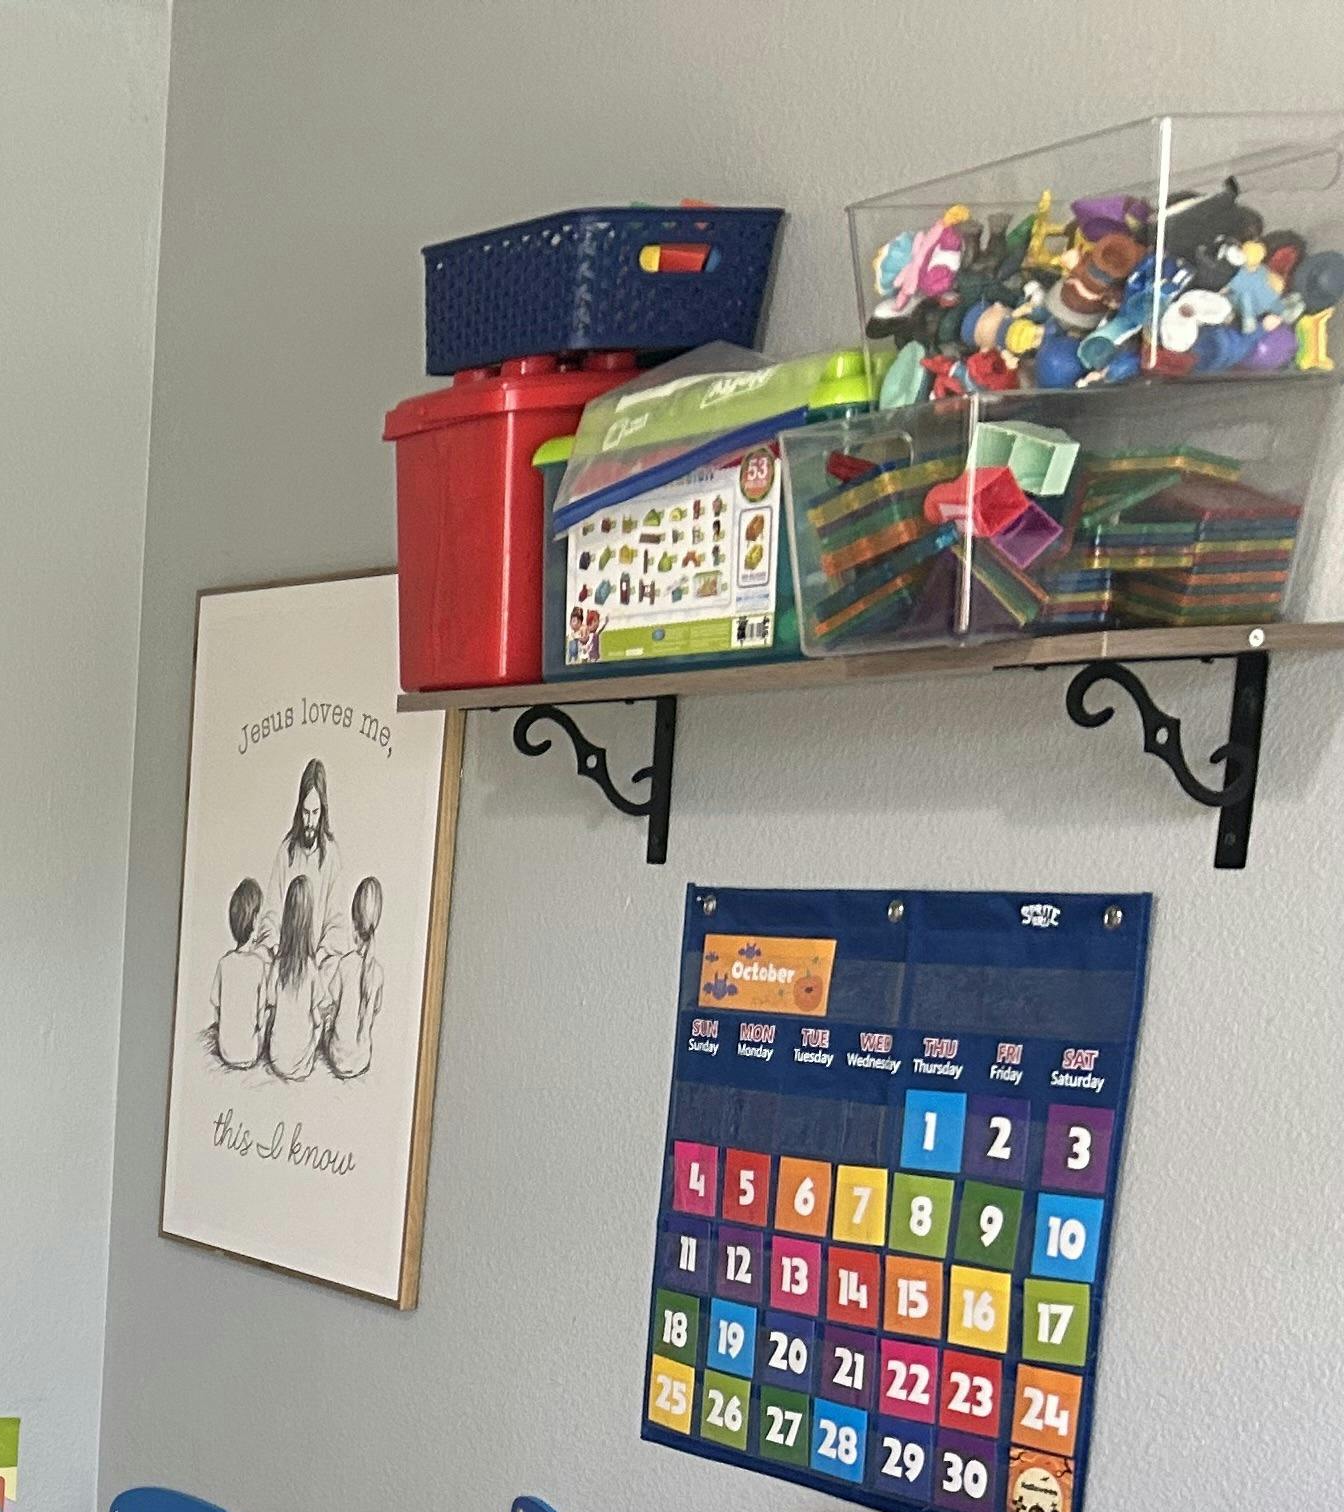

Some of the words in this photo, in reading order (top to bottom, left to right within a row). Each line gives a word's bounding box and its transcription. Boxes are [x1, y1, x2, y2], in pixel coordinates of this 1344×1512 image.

[746, 457, 768, 481] 53
[238, 707, 294, 755] Jesus
[302, 698, 353, 728] loves
[360, 713, 392, 758] me,
[731, 961, 795, 984] October
[688, 1038, 719, 1055] Sunday
[737, 1043, 773, 1060] Monday
[793, 1048, 834, 1068] Tuesday
[847, 1053, 901, 1074] Wednesday
[913, 1060, 962, 1079] Thursday
[990, 1065, 1022, 1085] Friday
[1051, 1071, 1104, 1092] Saturday
[692, 1019, 719, 1038] SUN
[740, 1022, 775, 1042] MON
[801, 1028, 829, 1047] TUE
[860, 1033, 892, 1052] WED
[923, 1037, 957, 1058] THU
[996, 1042, 1022, 1063] FRI
[1062, 1049, 1099, 1071] SAT
[213, 1109, 253, 1156] this
[256, 1122, 284, 1159] I
[288, 1122, 355, 1175] know
[923, 1113, 935, 1149] 1
[987, 1117, 1011, 1160] 2
[1068, 1128, 1090, 1170] 3
[689, 1162, 705, 1196] 4
[738, 1170, 755, 1205] 5
[794, 1178, 814, 1215] 6
[853, 1188, 870, 1223] 7
[909, 1196, 932, 1237] 8
[980, 1206, 1004, 1246] 9
[1047, 1216, 1085, 1260] 10
